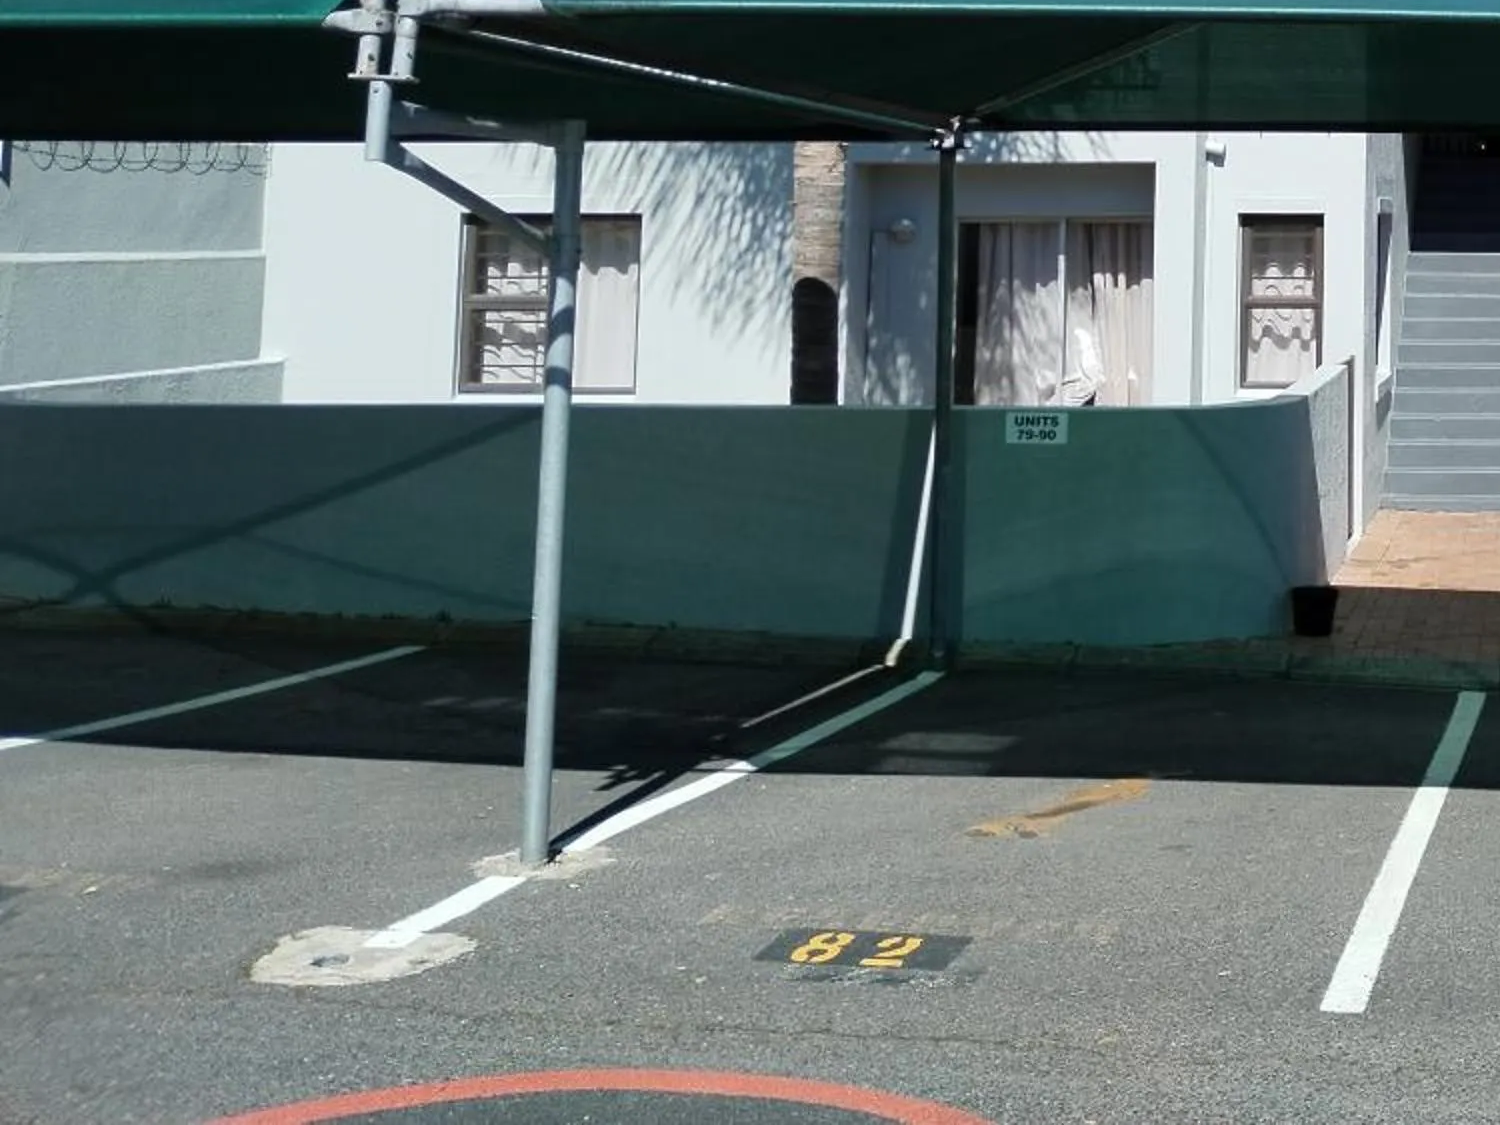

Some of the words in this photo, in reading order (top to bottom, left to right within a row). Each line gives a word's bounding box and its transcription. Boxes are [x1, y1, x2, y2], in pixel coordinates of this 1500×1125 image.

[1013, 416, 1059, 427] UNITS
[1016, 429, 1057, 441] 79-90
[789, 931, 924, 967] 82
